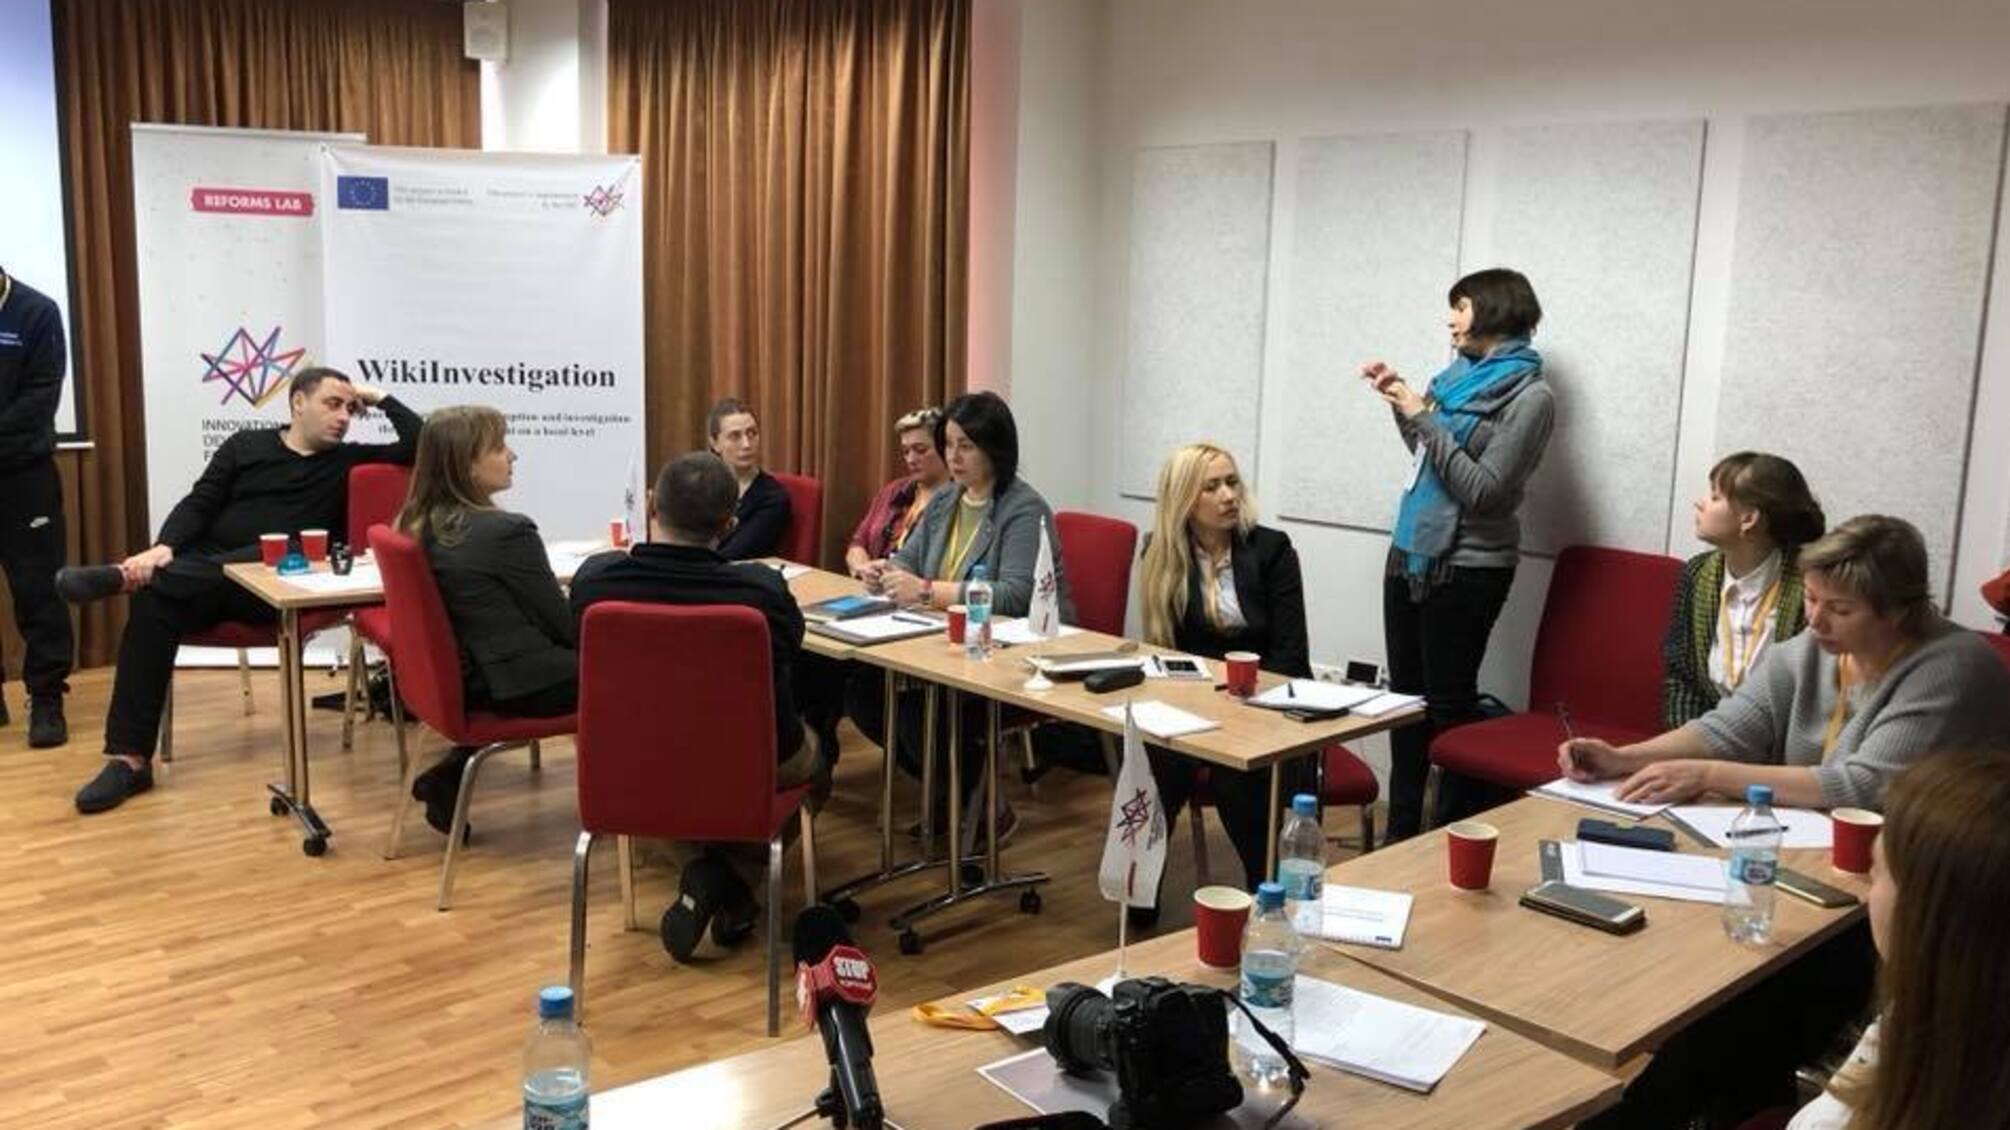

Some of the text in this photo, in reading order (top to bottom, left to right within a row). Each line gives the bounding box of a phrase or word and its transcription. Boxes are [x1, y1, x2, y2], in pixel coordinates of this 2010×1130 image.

[203, 194, 302, 211] REFORMS LAB
[357, 359, 615, 393] WikiInvestigation
[833, 956, 869, 981] STOP
